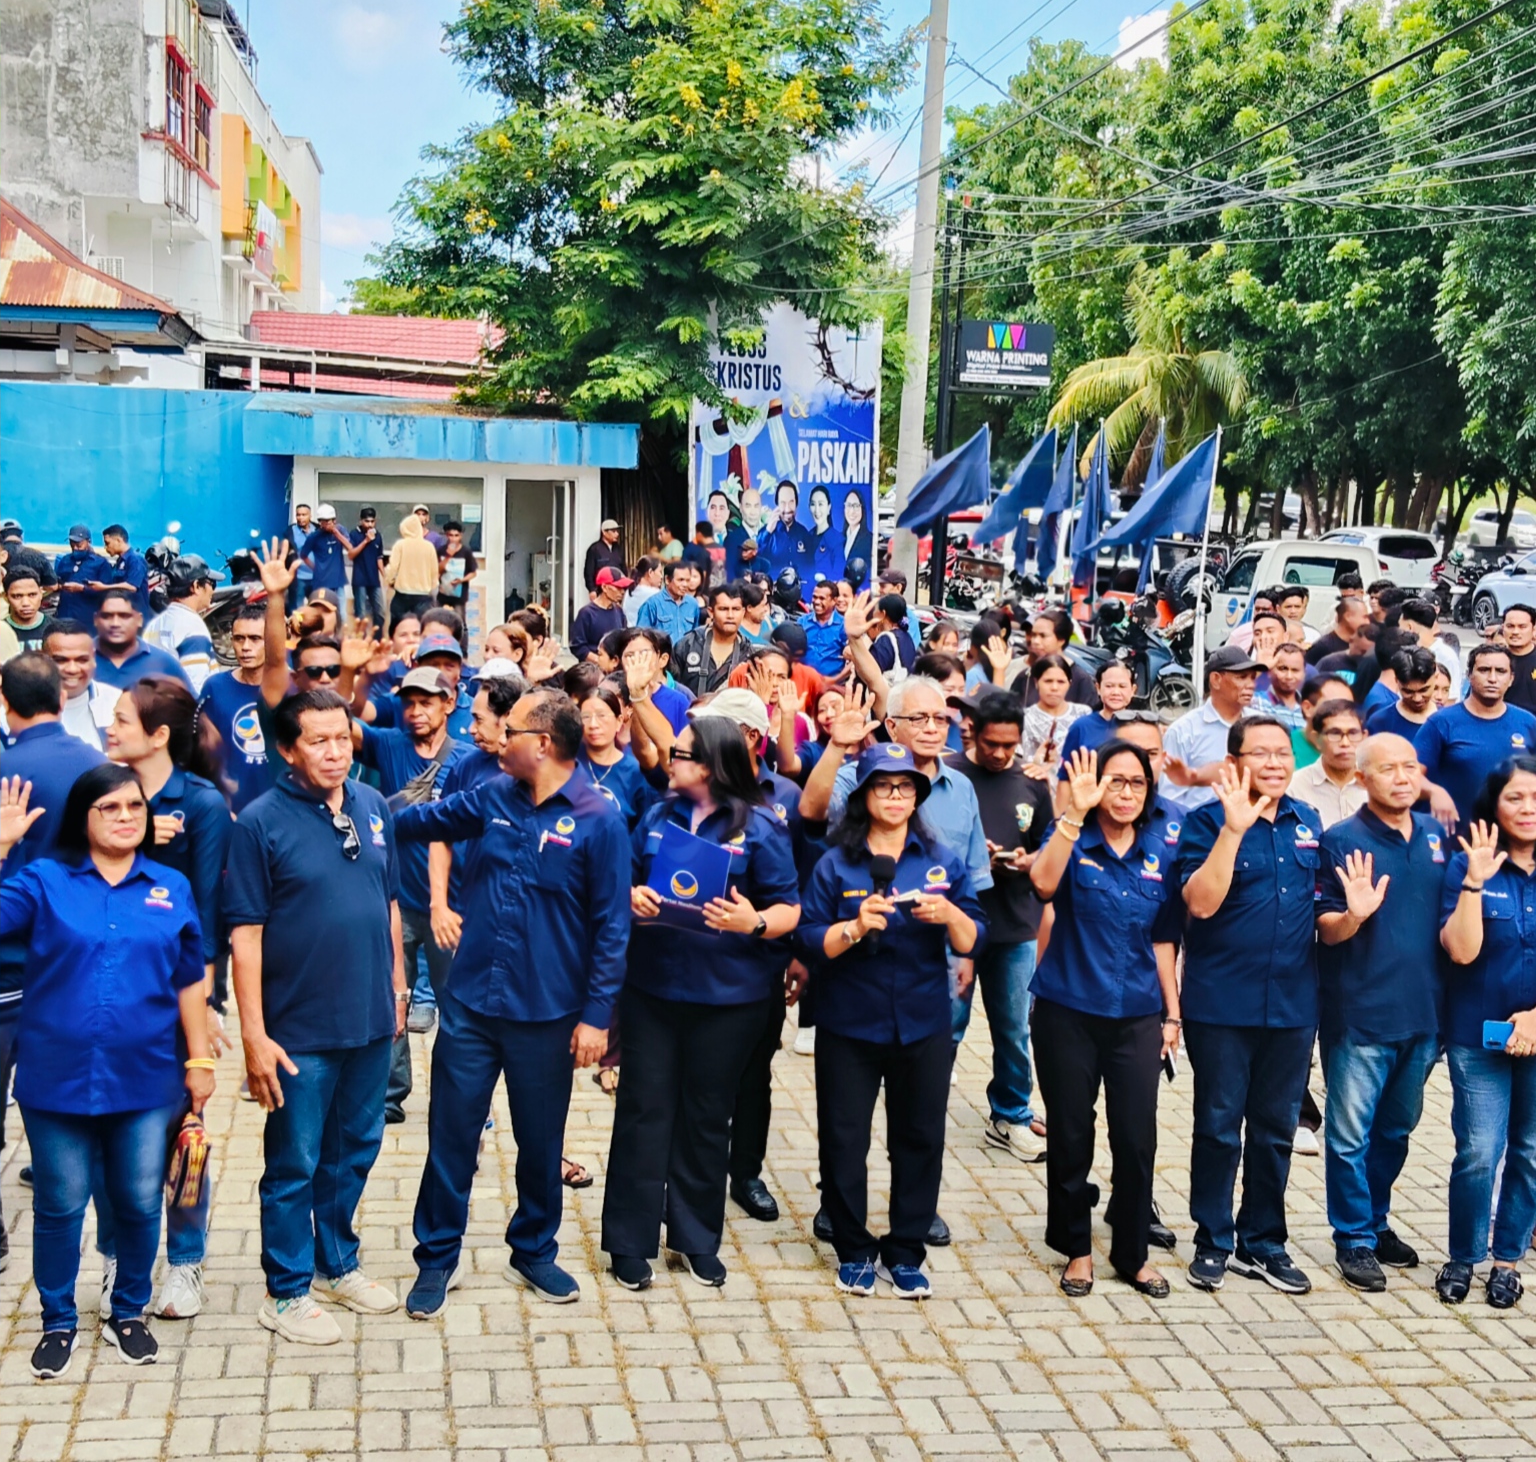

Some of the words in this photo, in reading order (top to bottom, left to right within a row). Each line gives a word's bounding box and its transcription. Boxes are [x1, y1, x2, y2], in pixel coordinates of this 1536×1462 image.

[966, 349, 1001, 363] WARNA
[1002, 351, 1048, 366] PRINTING
[717, 360, 782, 392] KRISTUS
[797, 440, 871, 485] PASKAH
